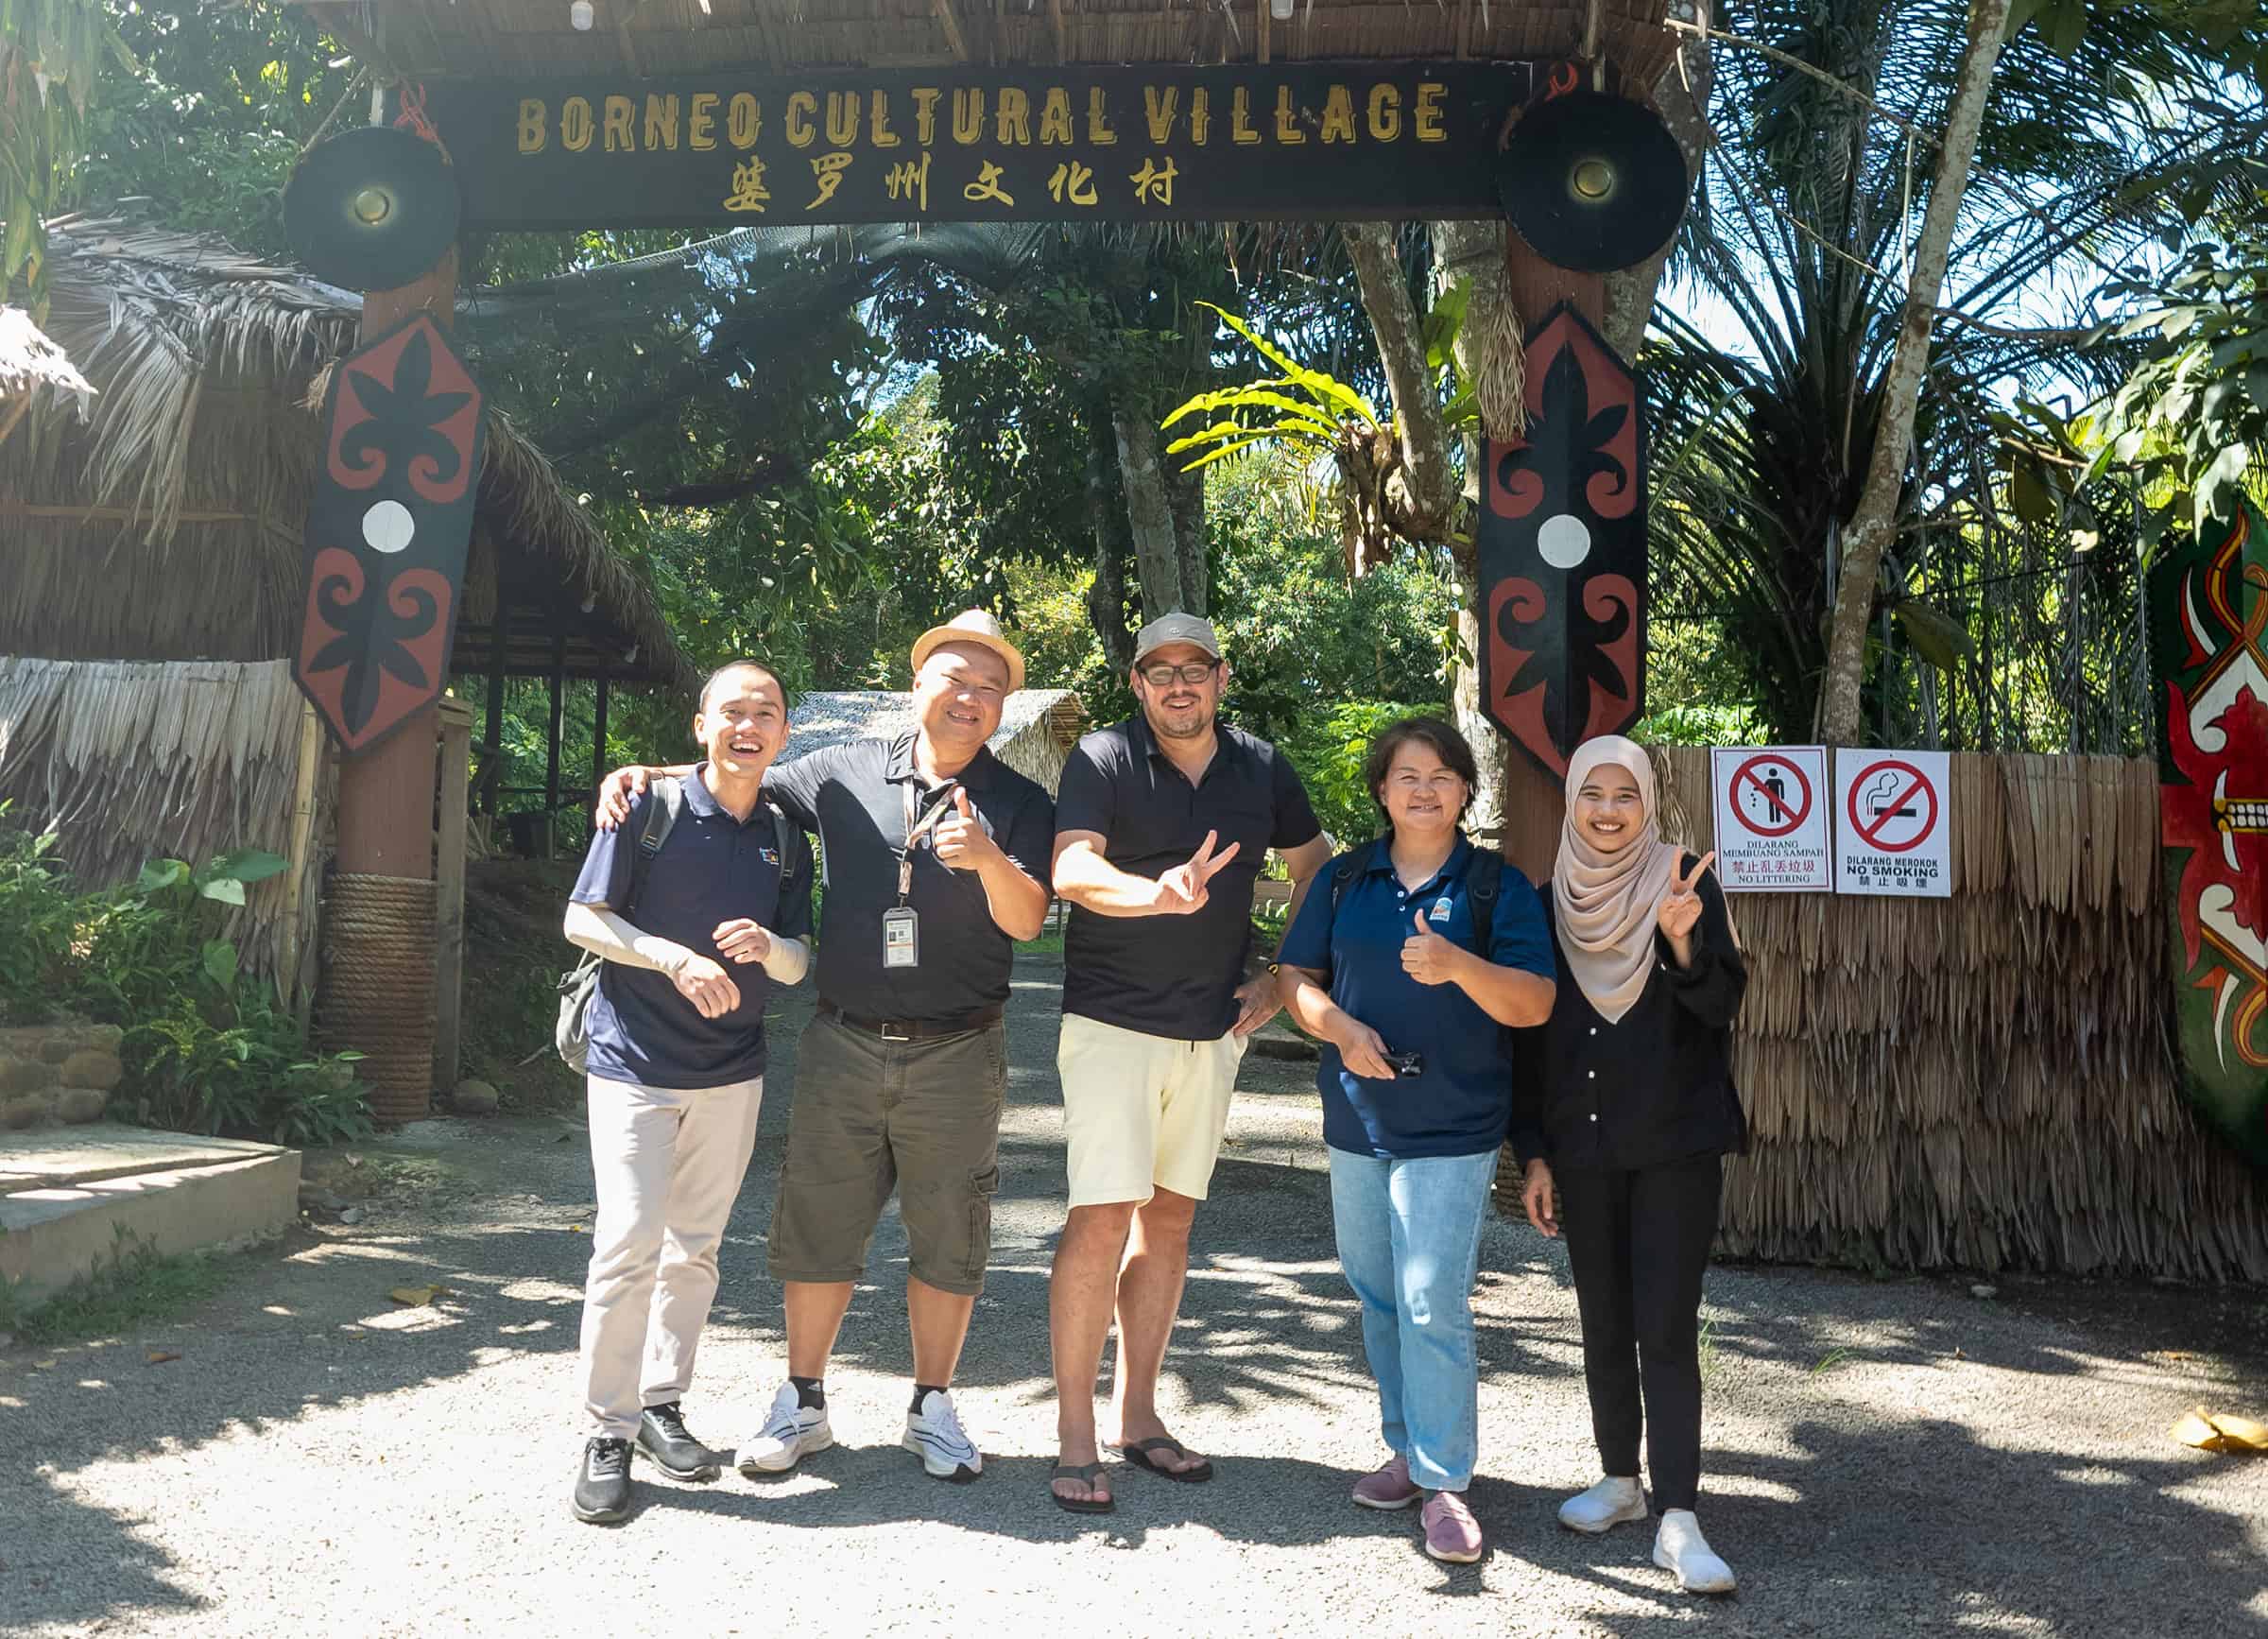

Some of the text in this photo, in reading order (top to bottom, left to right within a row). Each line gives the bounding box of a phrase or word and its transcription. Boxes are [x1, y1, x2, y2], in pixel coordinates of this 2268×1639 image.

[517, 82, 1450, 154] BORNEO CULTURAL VILLAGE
[1746, 839, 1799, 849] DILARANG
[1723, 848, 1824, 858] MEMBUANG SAMPAH
[1731, 859, 1815, 873] 禁止乱丢垃圾
[1847, 855, 1938, 869] DILARANG MEROKOK
[1847, 865, 1939, 878] NO SMOKING
[1738, 874, 1811, 884] NO LITTERING
